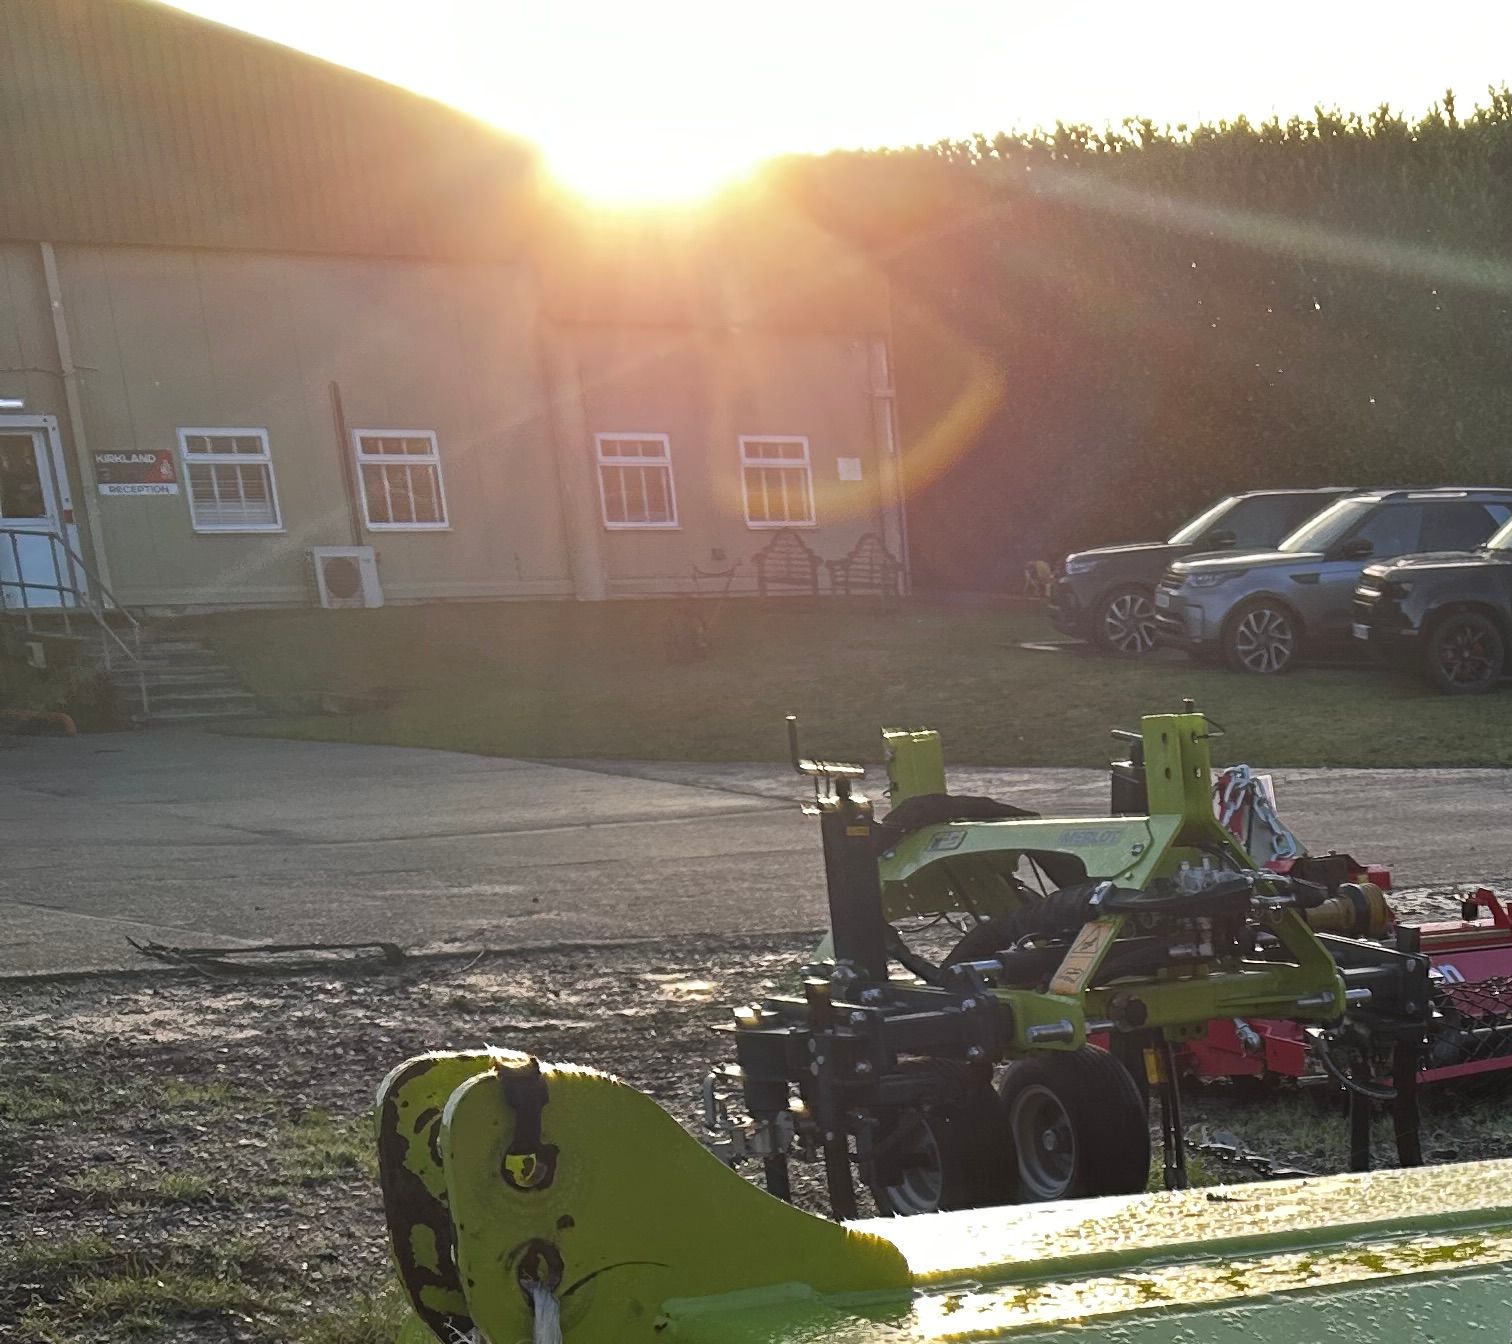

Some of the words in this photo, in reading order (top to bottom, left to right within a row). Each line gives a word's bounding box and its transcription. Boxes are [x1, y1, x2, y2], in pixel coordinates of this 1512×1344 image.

[96, 453, 156, 464] KIRKLAND
[108, 485, 169, 494] RECEPTION
[1058, 828, 1122, 846] MERLOT
